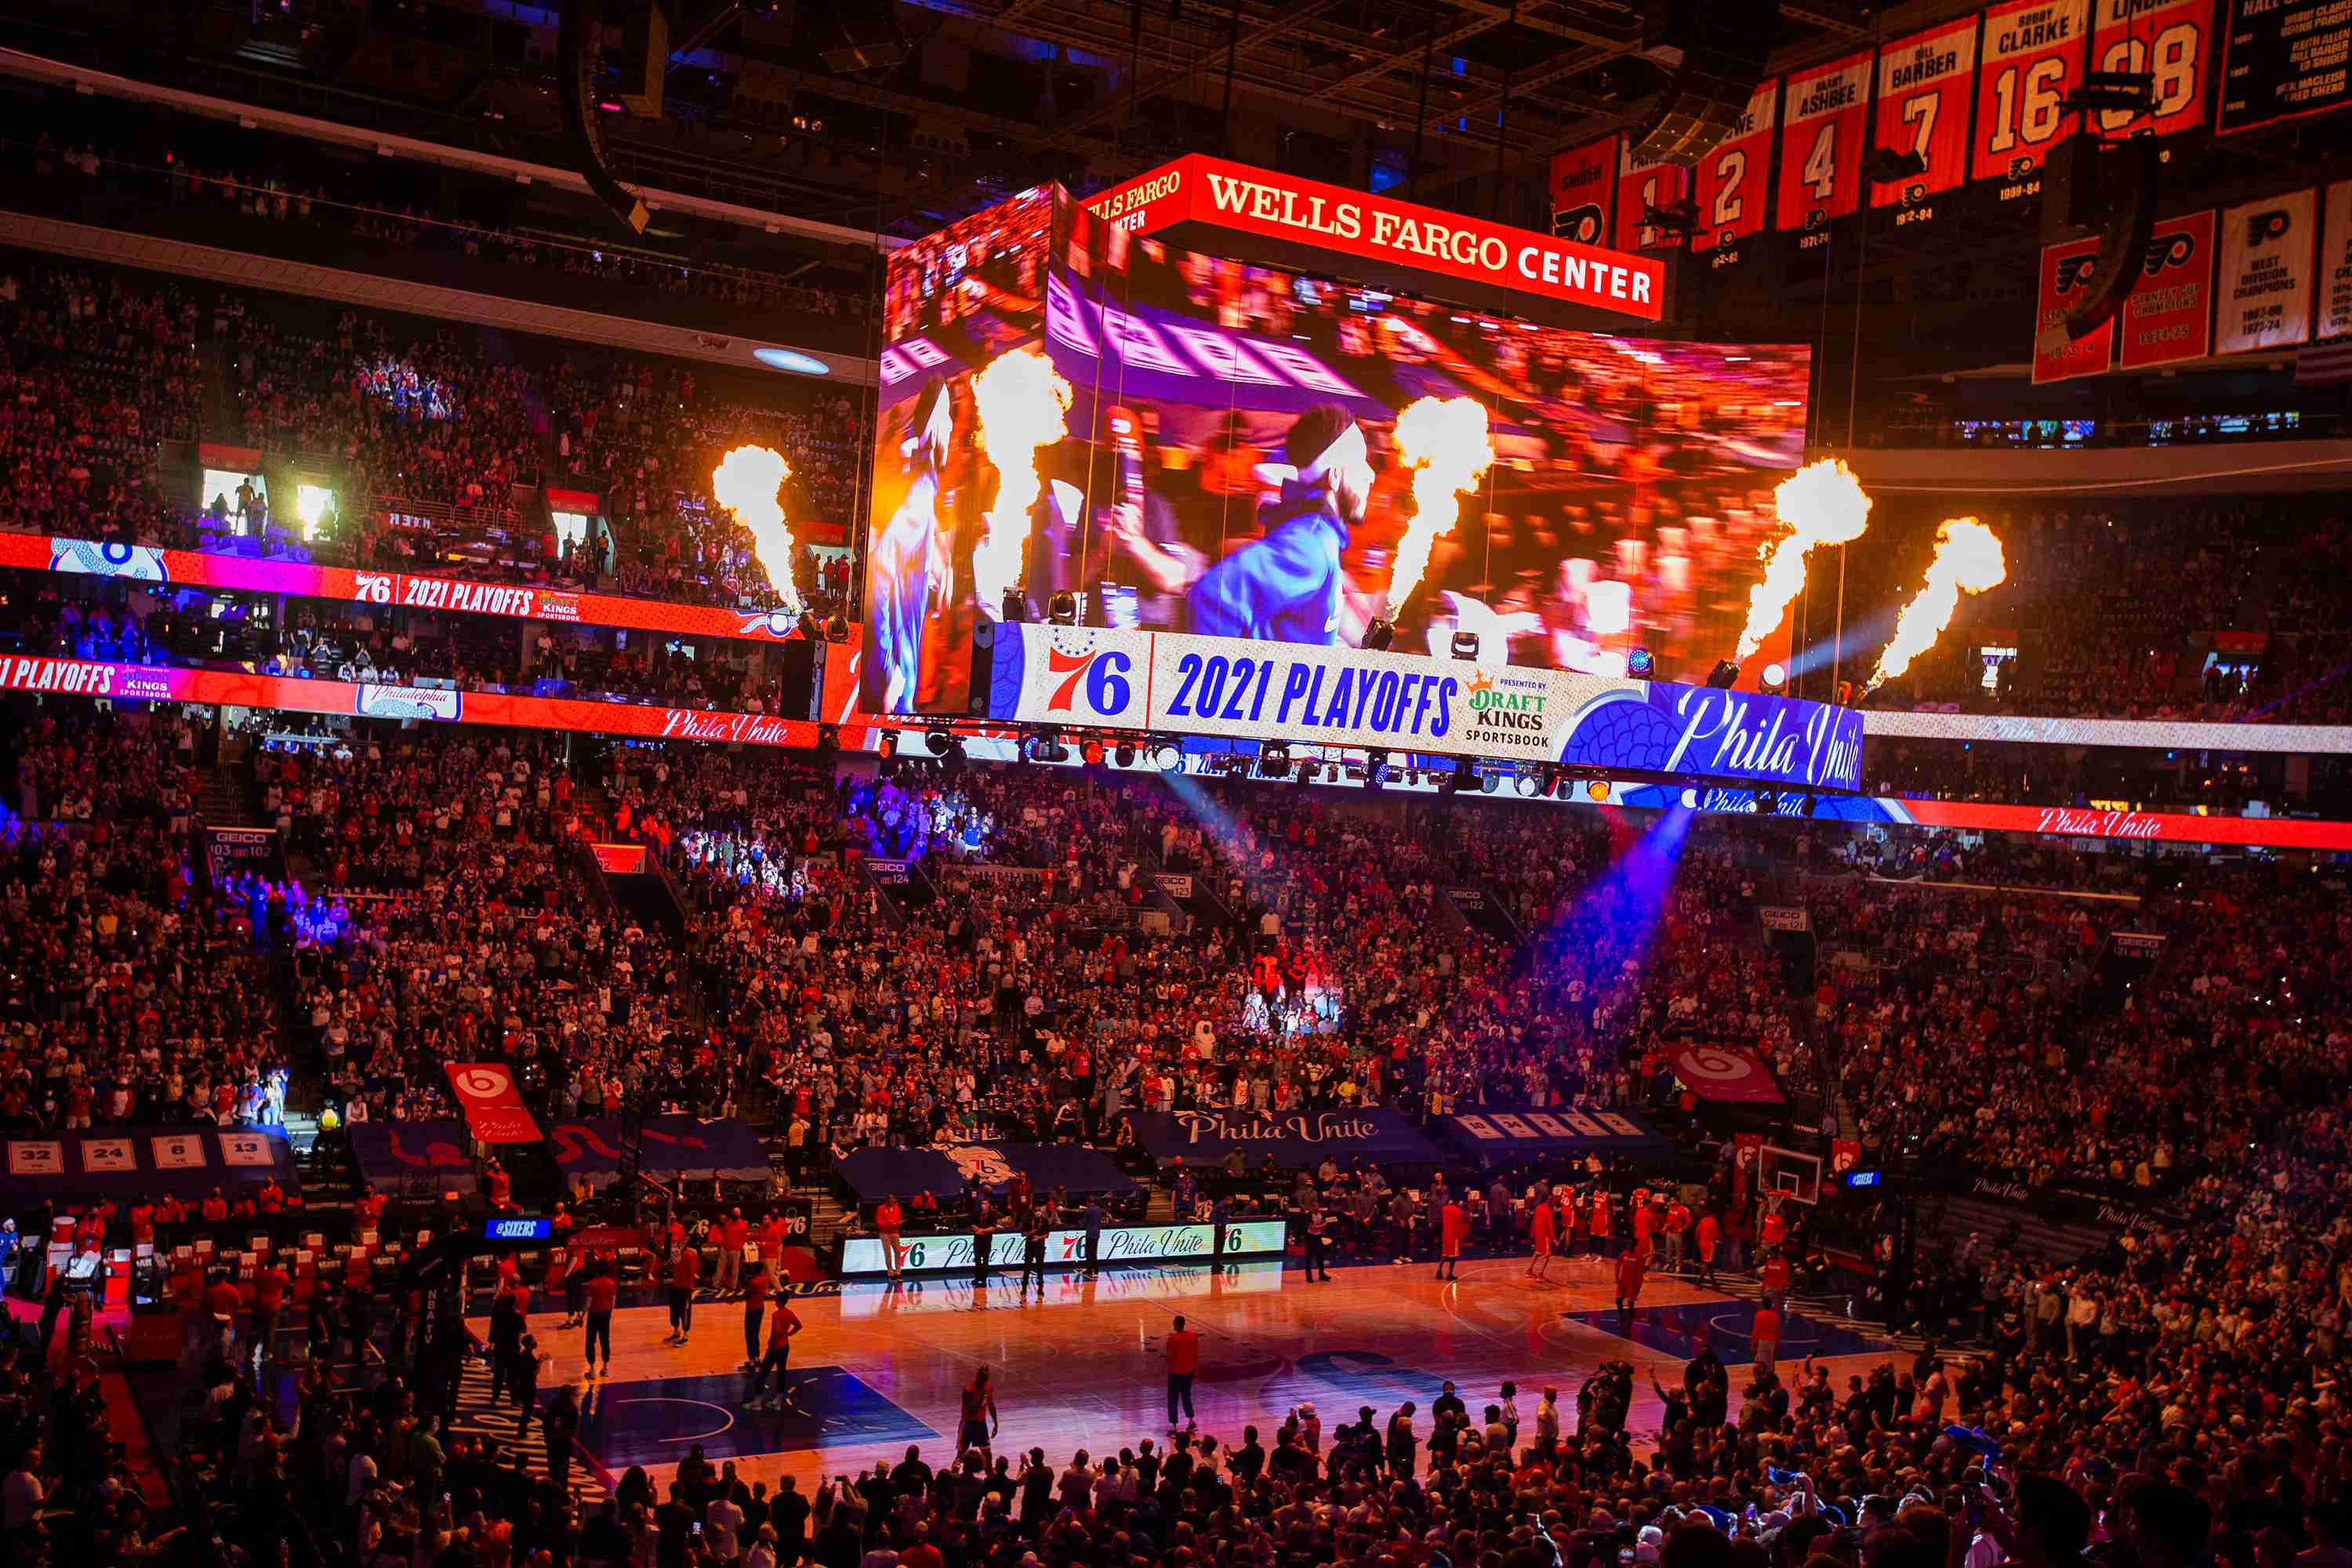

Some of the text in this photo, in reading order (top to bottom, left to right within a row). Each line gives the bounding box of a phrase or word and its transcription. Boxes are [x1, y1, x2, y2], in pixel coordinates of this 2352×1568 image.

[2020, 7, 2053, 27] BOBBY
[1999, 16, 2070, 53] CLARKE
[1893, 51, 1958, 89] BARBER
[1798, 83, 1856, 117] ASHBEE
[1991, 56, 2066, 154] 16
[1902, 89, 1940, 174] 7
[1803, 122, 1835, 201] 4
[1124, 170, 1181, 212] FARGO
[1713, 149, 1748, 227] 2
[1639, 174, 1657, 249] 1
[1207, 172, 1651, 305] WELLS FARGO CENTER
[354, 570, 535, 617] 76 2021 PLAYOFFS
[537, 612, 581, 622] SPORTSBOOK
[543, 604, 578, 615] KINGS
[12, 659, 115, 693] PLAYOFFS
[126, 680, 168, 691] KINGS
[1500, 678, 1536, 688] PRESENTED
[119, 688, 172, 699] SPORTSBOOK
[370, 684, 448, 702] Philadelphia
[1047, 645, 1460, 738] 76 2021 PLAYOFFS
[1468, 689, 1548, 713] DRAFT
[662, 709, 787, 743] Phila Unite
[1477, 708, 1544, 731] KINGS
[1465, 730, 1549, 747] SPORTSBOOK
[1664, 689, 1860, 787] Phila Unite
[2037, 808, 2161, 837] Phila Unite
[216, 833, 267, 844] GEICO
[209, 845, 273, 858] 103 102
[869, 863, 906, 873] GEICO
[892, 874, 910, 884] 124
[1468, 902, 1486, 910] 122
[1177, 1112, 1380, 1144] Phila Unite
[1504, 1120, 1522, 1129] 34
[20, 1150, 51, 1160] 32
[93, 1148, 123, 1158] 24
[171, 1145, 185, 1154] 6
[234, 1143, 257, 1152] 13
[496, 1221, 537, 1236] @SIXERS
[786, 1216, 806, 1235] 76
[896, 1242, 925, 1268] 76
[944, 1238, 996, 1268] Phla
[1106, 1230, 1155, 1260] Phila
[1159, 1226, 1203, 1256] Unite
[426, 1288, 437, 1319] NBA
